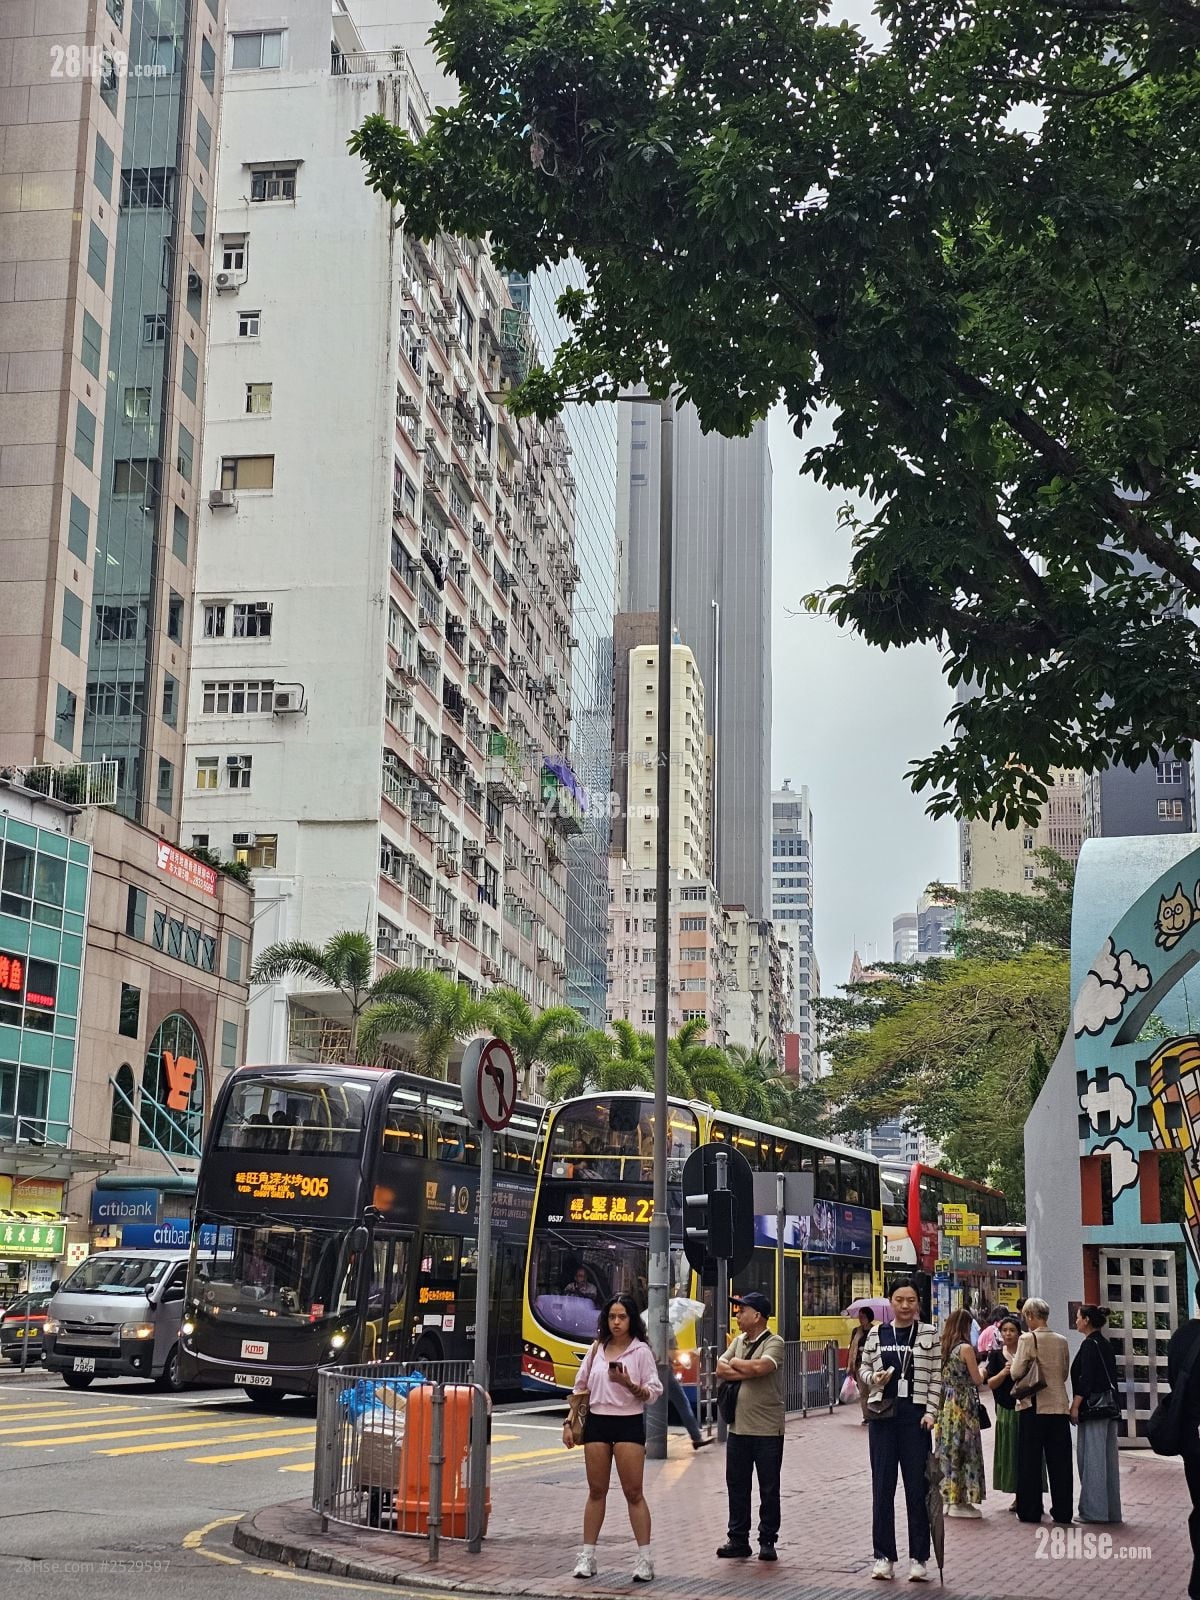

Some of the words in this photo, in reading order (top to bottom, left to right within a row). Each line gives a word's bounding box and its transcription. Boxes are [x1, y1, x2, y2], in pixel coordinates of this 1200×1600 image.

[300, 1176, 329, 1197] 905
[98, 1201, 152, 1216] citibank
[547, 1215, 563, 1223] 9537
[571, 1211, 582, 1220] via
[582, 1210, 608, 1221] Caine
[609, 1211, 635, 1222] Road
[244, 1345, 265, 1354] KMB
[236, 1373, 247, 1383] VM
[249, 1375, 271, 1385] 3892
